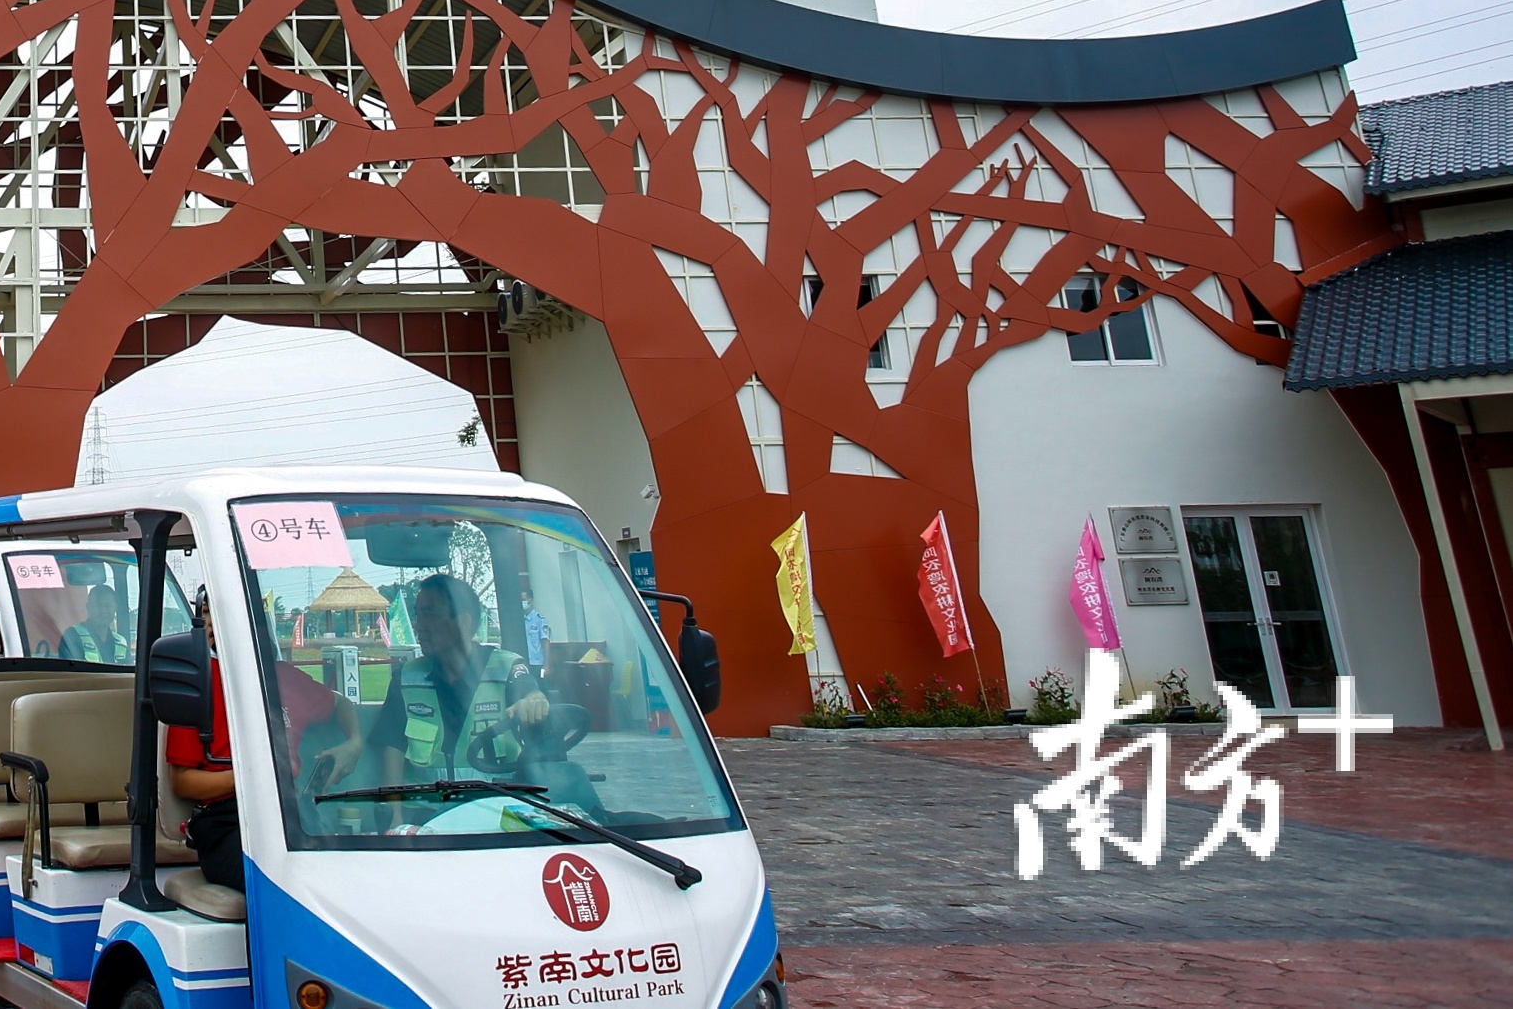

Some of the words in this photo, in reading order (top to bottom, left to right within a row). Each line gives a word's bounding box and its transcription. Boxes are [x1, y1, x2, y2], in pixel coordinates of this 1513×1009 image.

[495, 943, 682, 989] 紫南文化园
[503, 993, 560, 1009] Zinan
[568, 983, 640, 1007] Cultural
[646, 979, 685, 997] Park
